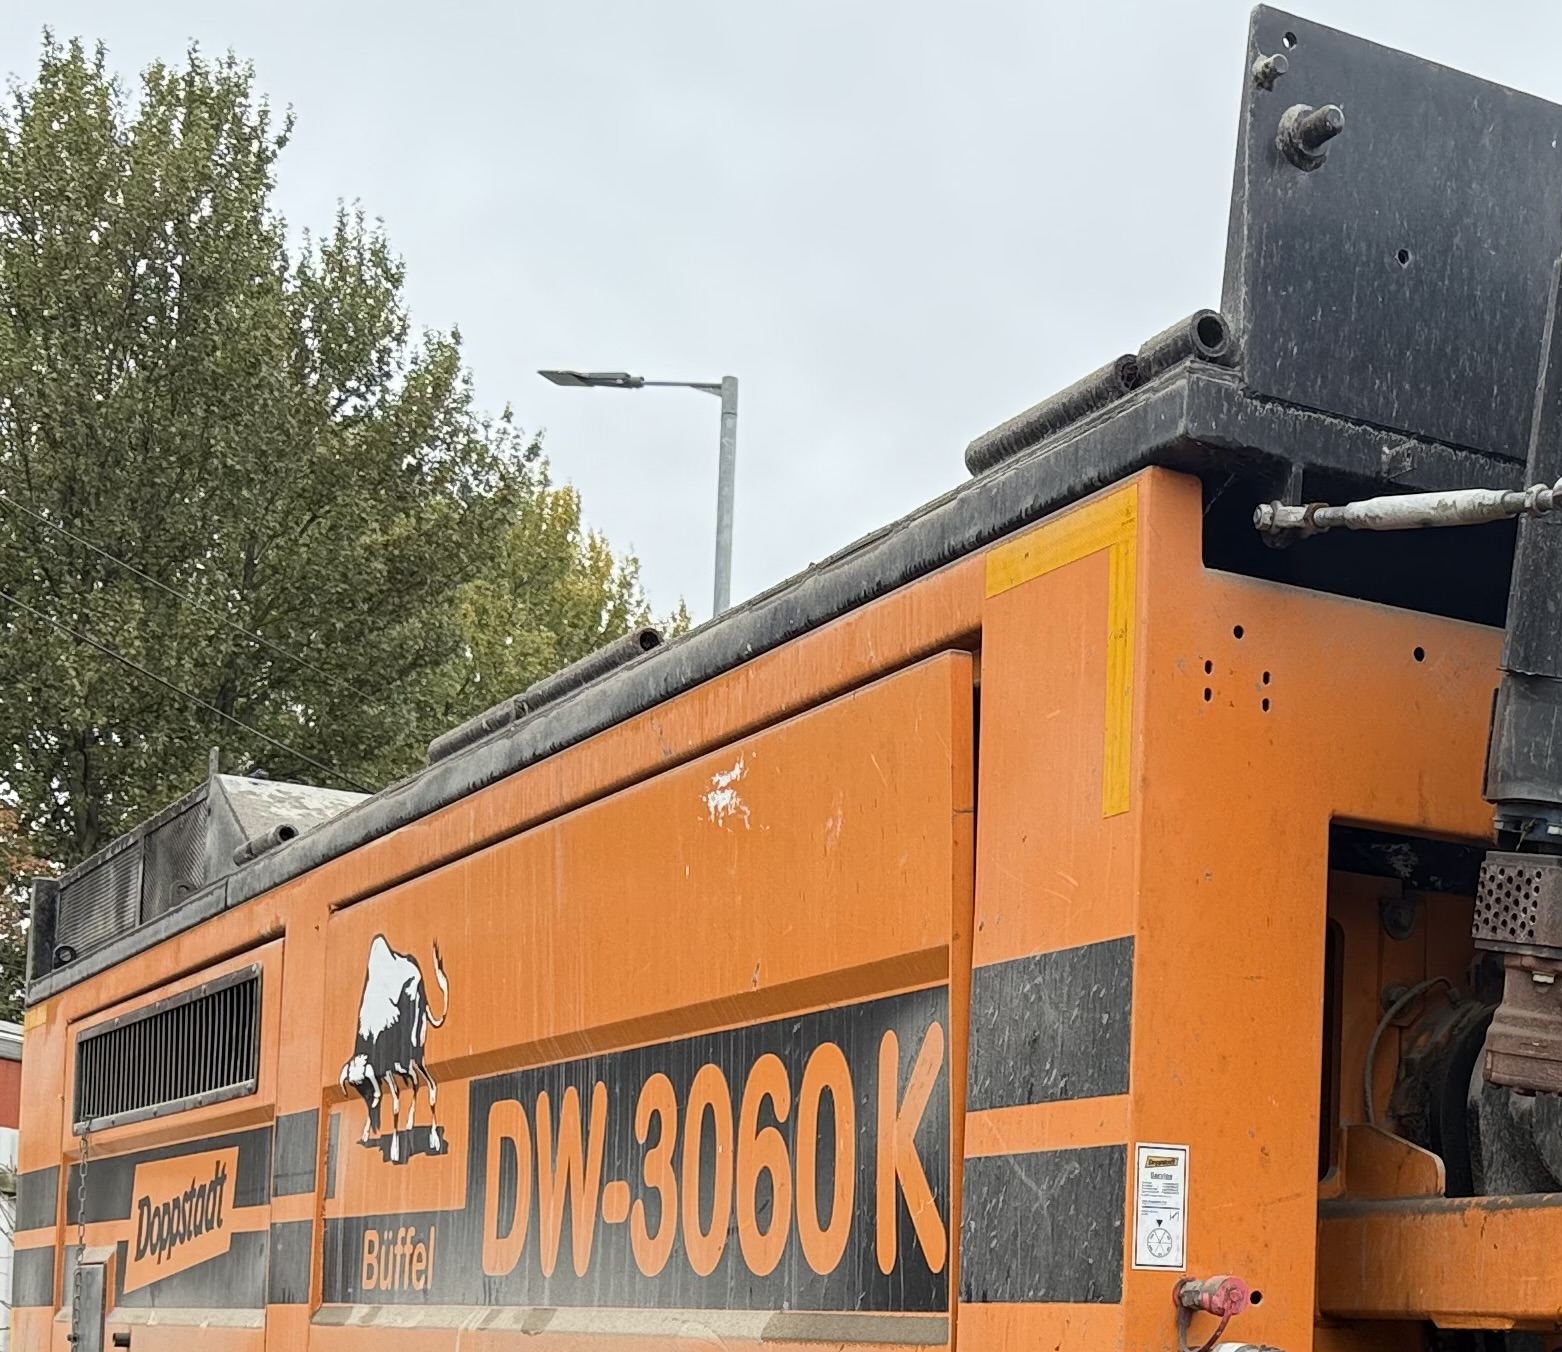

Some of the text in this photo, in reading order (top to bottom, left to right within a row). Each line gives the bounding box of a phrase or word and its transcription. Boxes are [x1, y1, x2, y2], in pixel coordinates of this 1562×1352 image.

[481, 1020, 947, 1278] DW-3060 K
[134, 1160, 227, 1265] Doppstadt
[361, 1226, 435, 1291] Büffel
